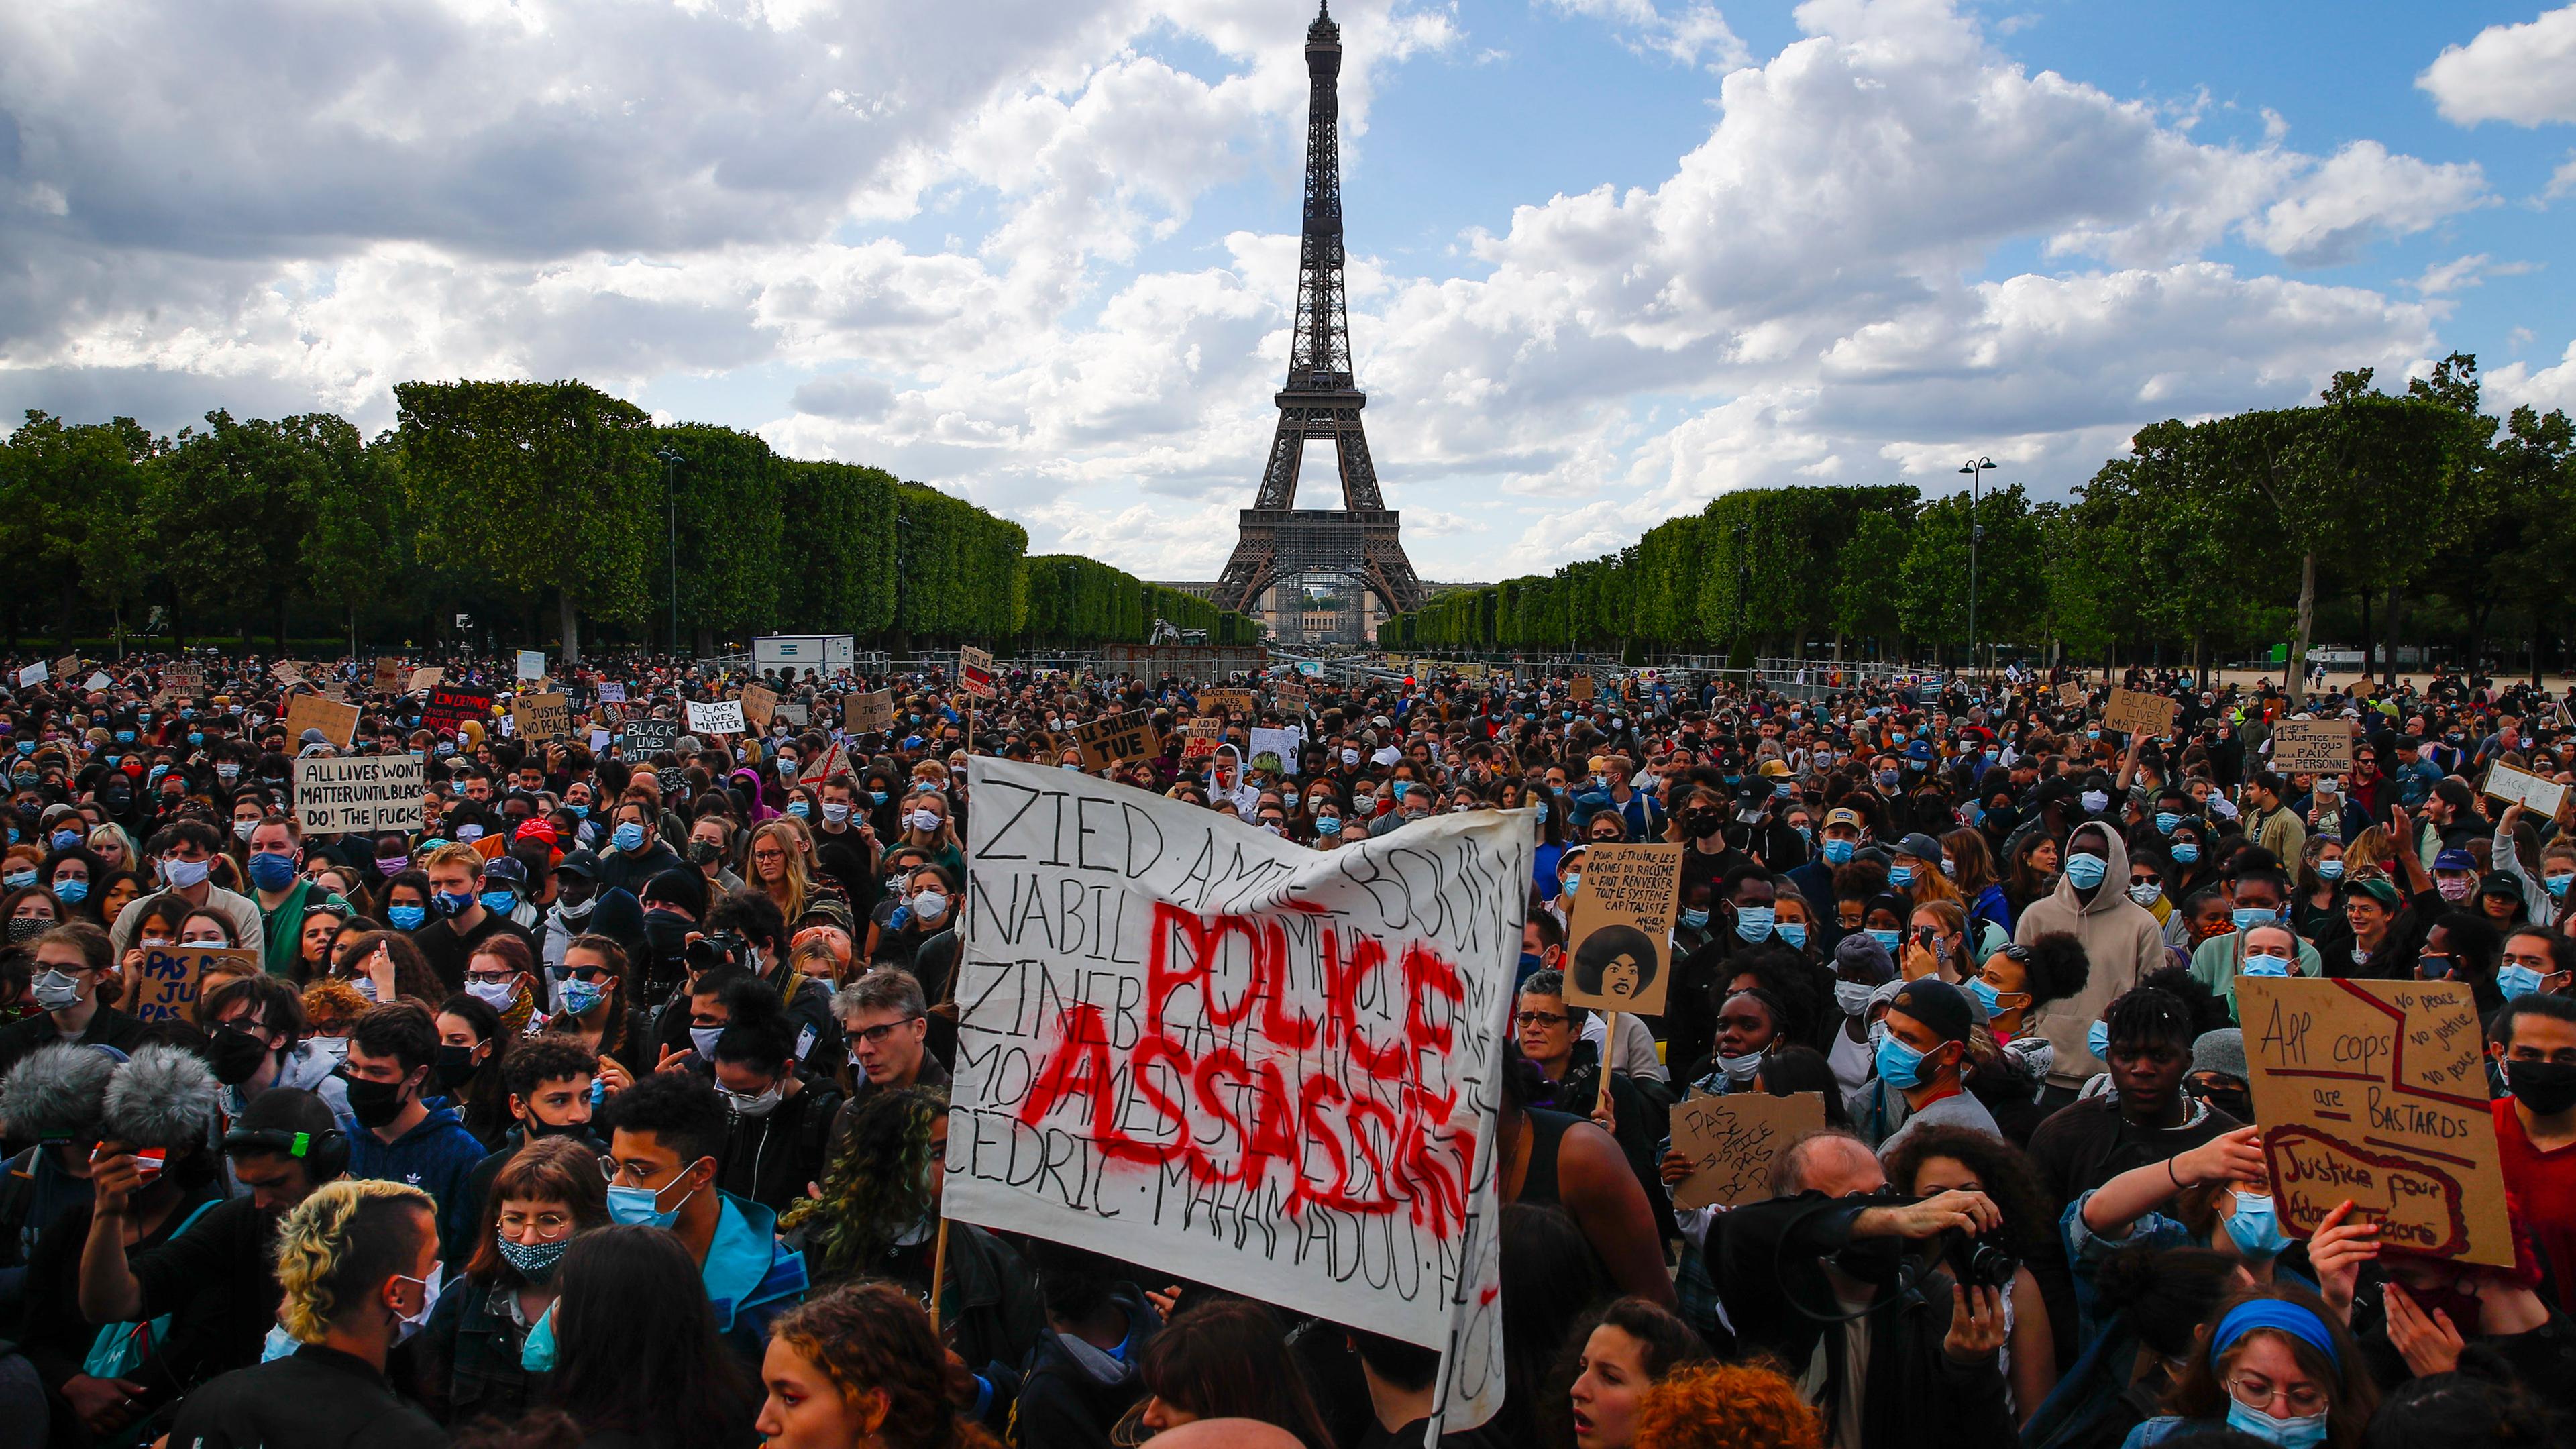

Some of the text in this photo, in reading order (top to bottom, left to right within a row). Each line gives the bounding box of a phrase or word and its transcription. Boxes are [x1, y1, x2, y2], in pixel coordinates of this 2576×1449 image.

[565, 688, 573, 696] US
[519, 700, 533, 710] NO
[532, 704, 568, 719] JUSTICE
[693, 704, 735, 713] BLACK
[862, 703, 887, 715] JUSTICE
[2121, 692, 2169, 714] BLACK
[704, 712, 735, 722] LIVES
[1197, 720, 1210, 728] NO
[2126, 707, 2162, 724] LIVES
[523, 721, 539, 735] NO
[542, 718, 570, 733] PEACE
[627, 723, 676, 737] BLACK
[694, 720, 742, 733] MATTER
[1079, 726, 1097, 743] LE
[1187, 729, 1217, 738] JUSTICE
[2112, 718, 2163, 737] MATTER
[637, 737, 665, 747] LIVES
[1194, 738, 1206, 746] NO
[1252, 730, 1294, 745] BLACK
[2288, 731, 2328, 741] JUSTICE
[1093, 733, 1145, 762] TUE
[1185, 745, 1215, 757] PEACE
[2298, 748, 2330, 758] PAIX
[306, 759, 423, 782] ALL LIVES WON'T
[2295, 759, 2349, 769] PERSONNE
[2493, 771, 2557, 795] BLACK LIVES
[301, 784, 425, 804] MATTER UNTIL BLACK
[307, 808, 335, 828] DO!
[340, 807, 370, 825] THE
[975, 778, 1163, 879] ZIED
[1593, 851, 1613, 861] POUR
[1660, 853, 1676, 863] LES
[1624, 864, 1634, 873] DU
[1599, 876, 1619, 888] FAUT
[1595, 887, 1616, 899] TOUT
[1616, 886, 1626, 898] LE
[968, 870, 1140, 965] NABIL
[1635, 916, 1665, 926] ANGELA
[144, 950, 190, 981] PAS
[958, 960, 1142, 1051] ZINEB
[2394, 991, 2460, 1013] No peace
[140, 1002, 182, 1022] PAS
[1148, 900, 1465, 1126] POLICE
[2261, 998, 2390, 1075] All cops
[2410, 1030, 2430, 1046] No
[2422, 1049, 2478, 1086] No peace
[957, 1032, 1186, 1136] MOHAMED
[2313, 1089, 2344, 1108] are
[1019, 1002, 1477, 1240] ASSASSIN
[1685, 1106, 1736, 1140] PAS
[1713, 1122, 1743, 1143] DE
[1731, 1144, 1774, 1171] PAS
[2275, 1140, 2441, 1208] Justice pour
[1719, 1173, 1747, 1202] DE
[944, 1104, 1120, 1218] CEDRIC
[1154, 1144, 1419, 1302] MAHAMADOU
